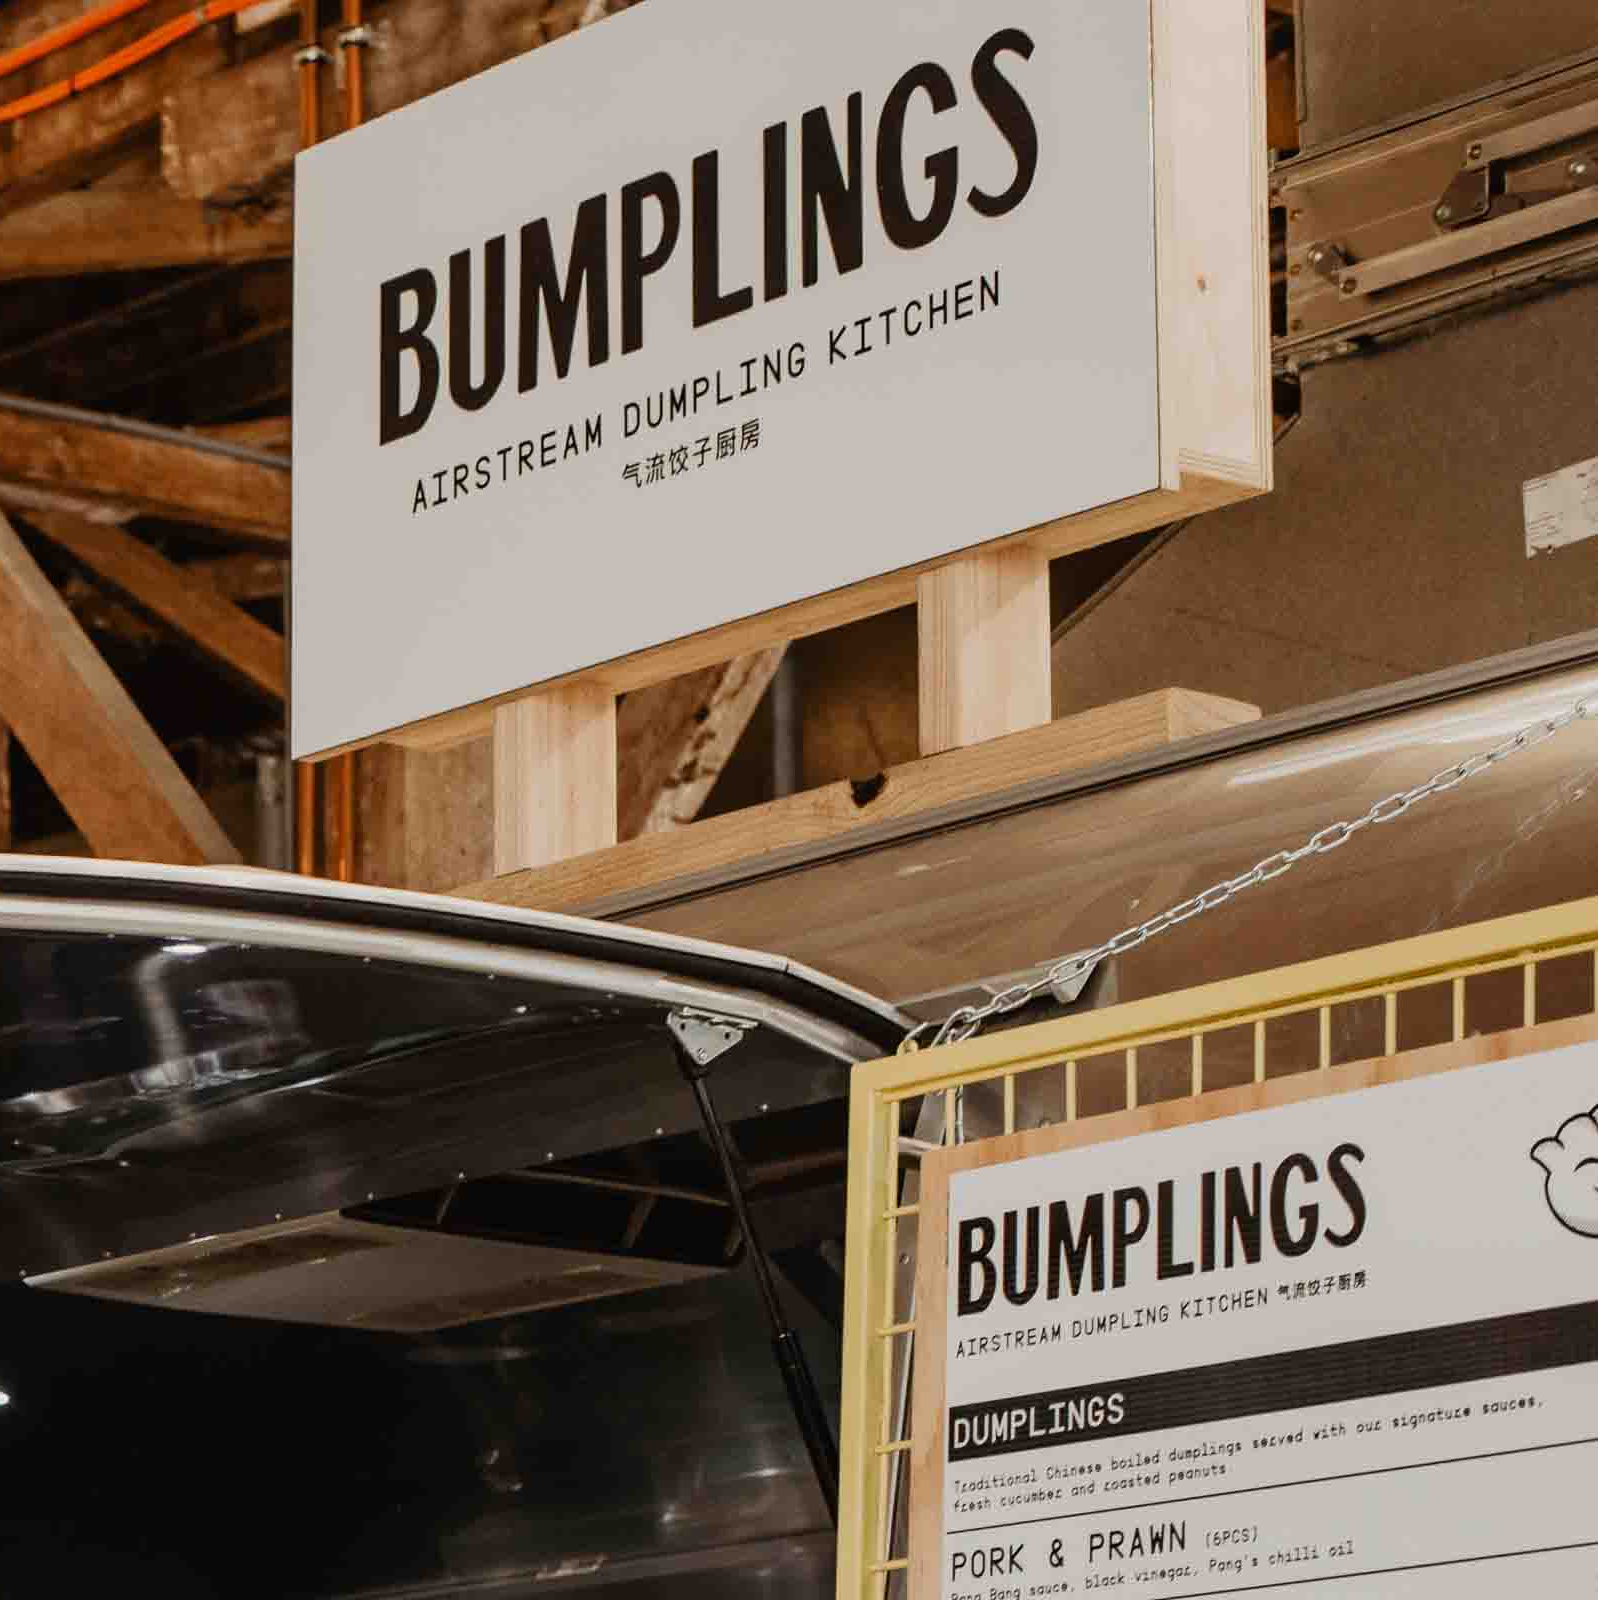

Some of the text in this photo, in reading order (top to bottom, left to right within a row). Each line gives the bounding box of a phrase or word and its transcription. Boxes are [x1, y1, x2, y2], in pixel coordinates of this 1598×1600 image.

[379, 27, 1038, 447] BUMPLINGS
[412, 270, 999, 514] AIRSTREAM DUMPLING KITCHEN
[622, 418, 760, 488] 气流饺子厨房
[957, 1142, 1366, 1317] BUMPLINGS
[956, 1323, 1061, 1358] AIRSTREAM
[1072, 1305, 1169, 1338] DUMPLING
[1180, 1288, 1268, 1320] KITCHEN
[953, 1392, 1125, 1449] DUMPLINGS
[954, 1468, 1037, 1494] Traditional
[1046, 1464, 1102, 1480] Chinese
[1111, 1450, 1160, 1471] boiled
[1168, 1442, 1242, 1462] dumplings
[1252, 1428, 1303, 1449] served
[1313, 1423, 1346, 1440] with
[1356, 1420, 1382, 1433] our
[1392, 1407, 1471, 1430] signature
[954, 1464, 1226, 1513] fresh cucumber and roasted peanuts
[952, 1544, 1024, 1582] PORK
[1049, 1538, 1064, 1568] &
[1089, 1520, 1185, 1563] PRAWN
[1085, 1571, 1125, 1590] black
[1209, 1555, 1258, 1574] Pang's
[1268, 1546, 1320, 1565] chilli
[1329, 1540, 1354, 1557] oil
